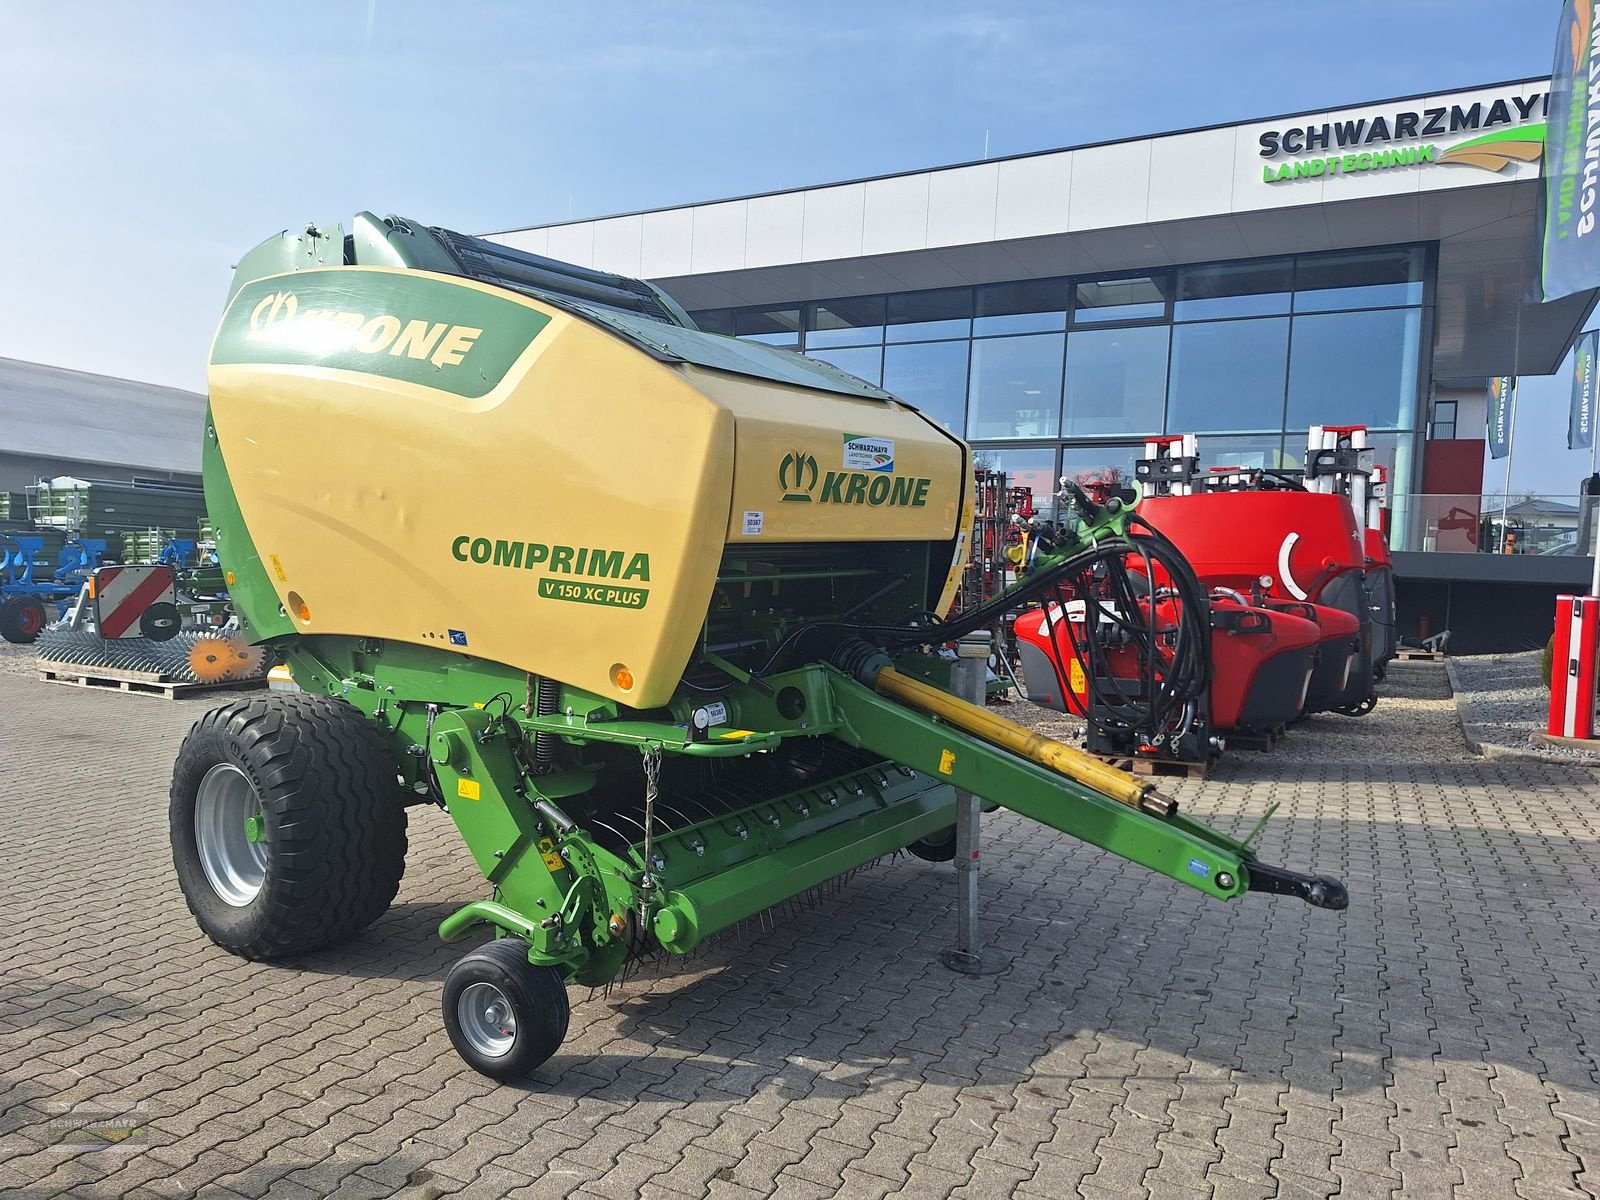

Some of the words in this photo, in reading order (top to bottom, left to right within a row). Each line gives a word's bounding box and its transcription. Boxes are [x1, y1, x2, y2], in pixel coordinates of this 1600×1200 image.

[1263, 144, 1435, 182] LANDTECHNIK
[848, 442, 888, 454] SCHWARZMAYR
[818, 471, 931, 507] KRONE
[451, 535, 651, 582] COMPRIMA
[544, 582, 555, 595] V
[558, 584, 581, 599] 150
[584, 587, 604, 601] XC
[606, 590, 642, 605] PLUS
